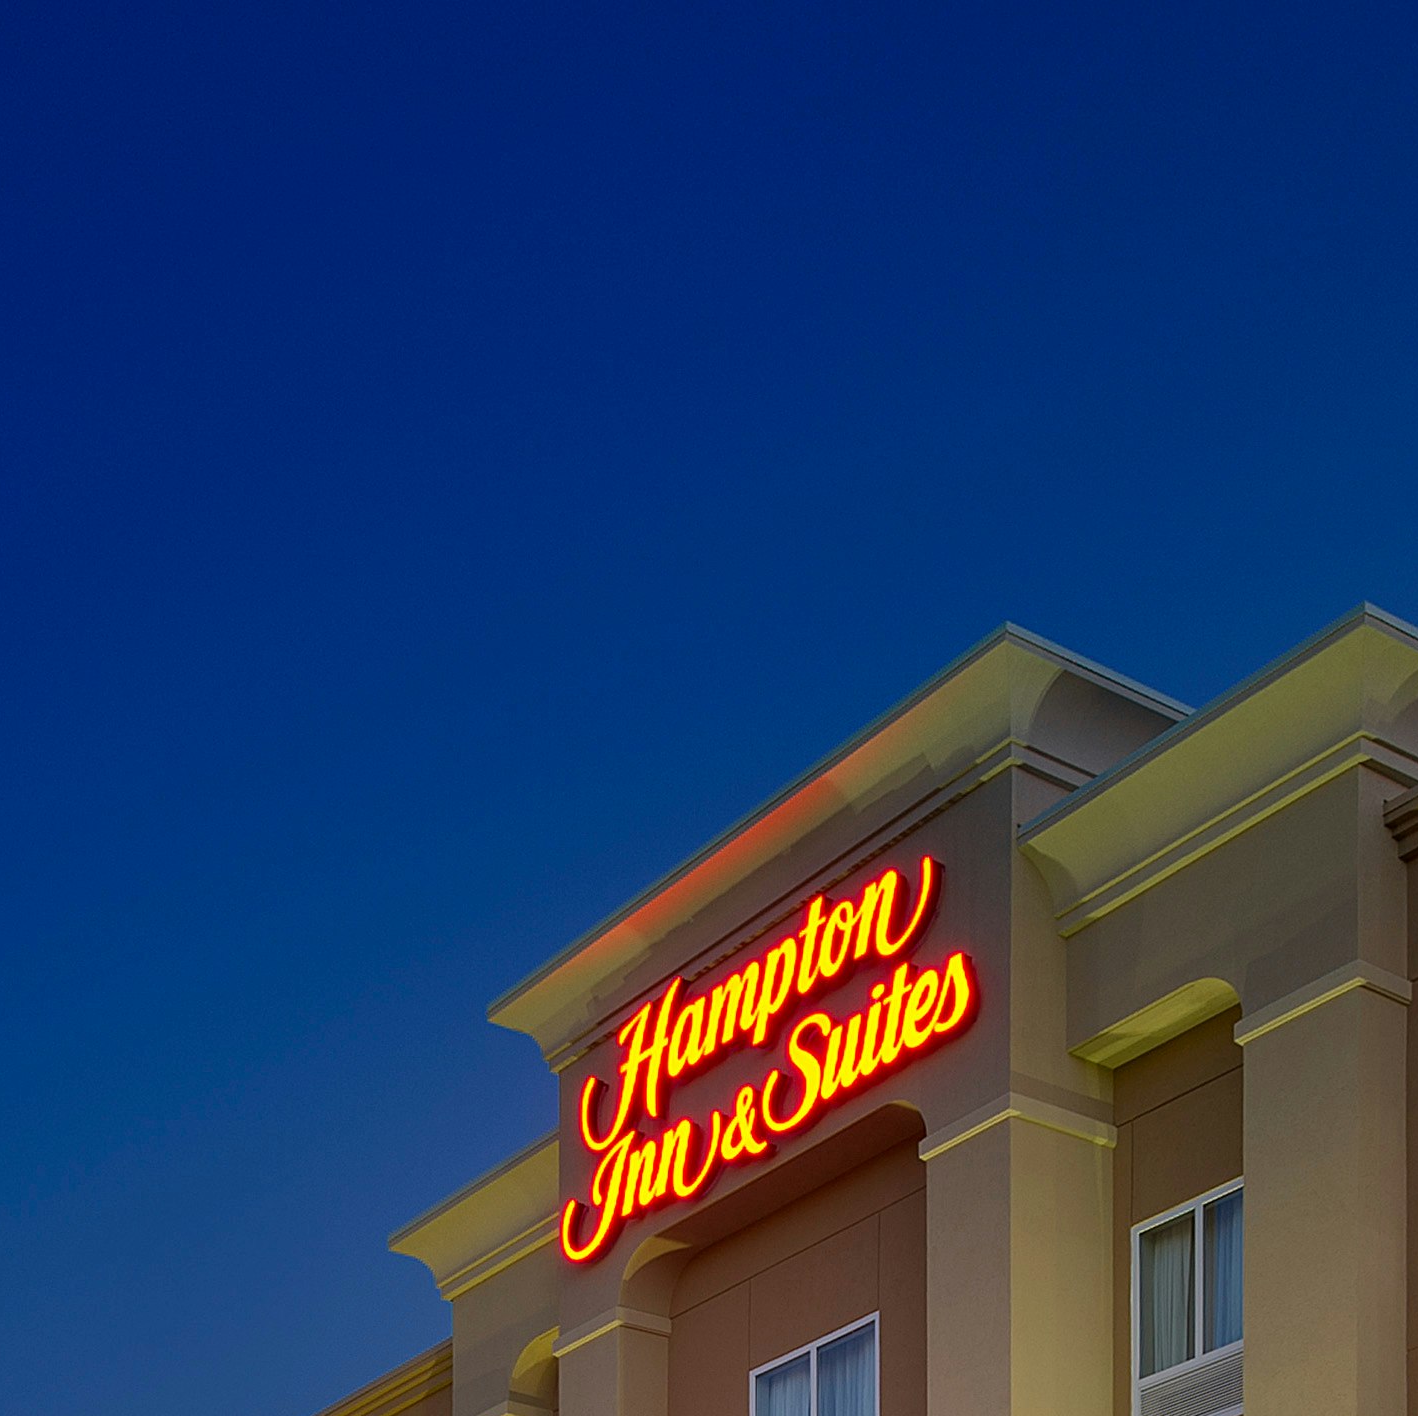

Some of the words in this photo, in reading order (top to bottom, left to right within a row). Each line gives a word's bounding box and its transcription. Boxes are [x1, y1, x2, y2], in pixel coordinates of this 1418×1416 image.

[561, 1108, 722, 1262] Inn
[719, 1084, 769, 1161] &
[761, 951, 972, 1133] Suites
[580, 855, 934, 1152] Hampton
